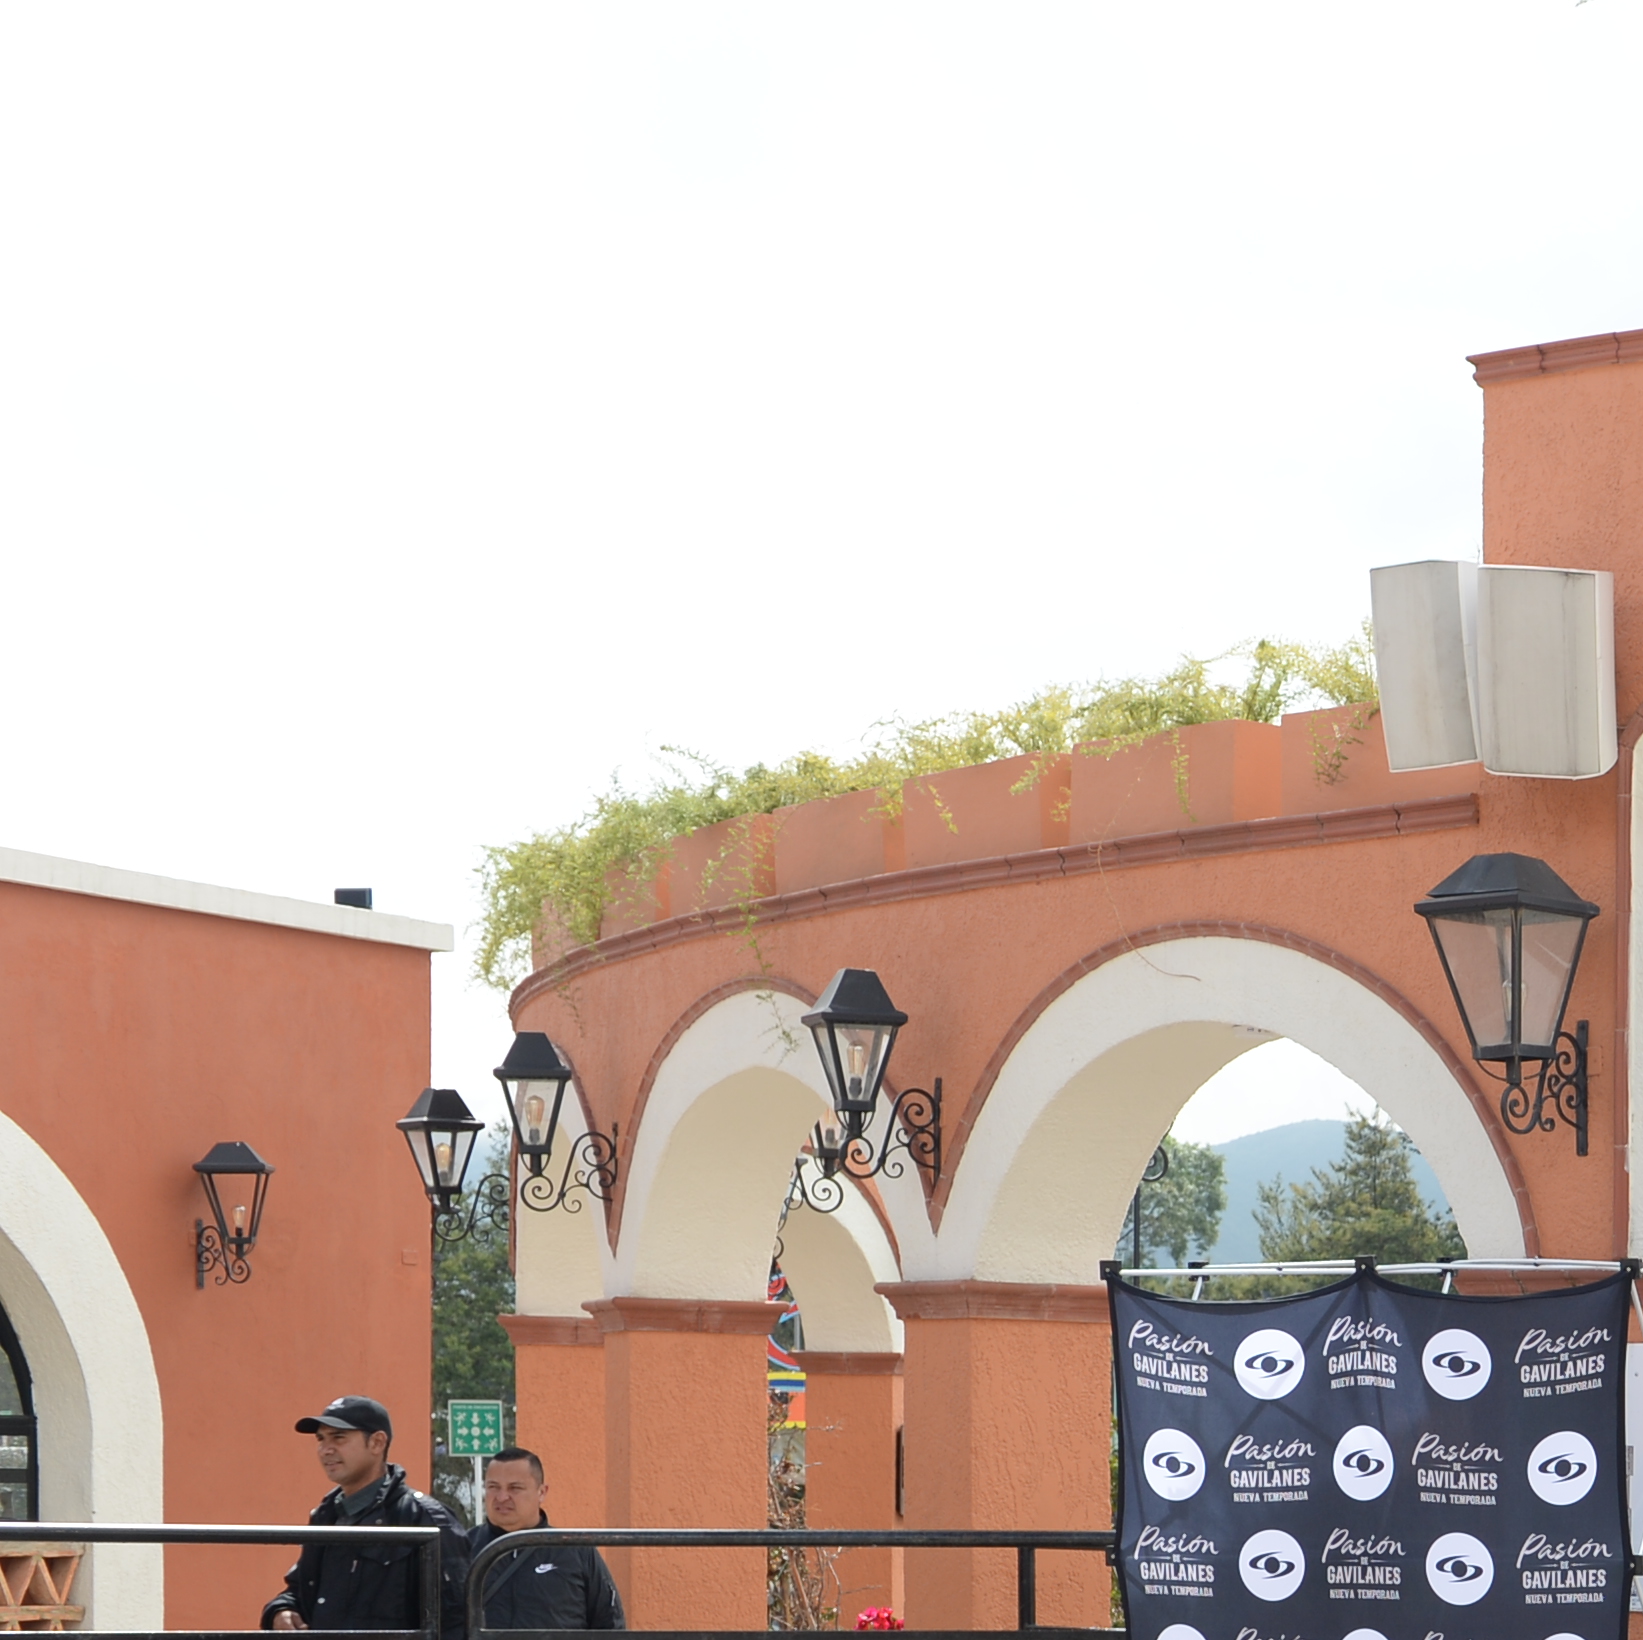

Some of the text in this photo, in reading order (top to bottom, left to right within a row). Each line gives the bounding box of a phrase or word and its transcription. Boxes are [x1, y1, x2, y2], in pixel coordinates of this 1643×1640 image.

[1128, 1320, 1213, 1355] Pasión
[1323, 1316, 1402, 1355] Pasión
[1515, 1327, 1611, 1363] Pasión
[1133, 1353, 1208, 1382] GAVILANES
[1328, 1349, 1396, 1374] GAVILANES
[1521, 1354, 1605, 1383] GAVILANES
[1224, 1435, 1316, 1468] Pasión
[1412, 1432, 1503, 1465] Pasión
[1231, 1468, 1310, 1487] GAVILANES
[1418, 1469, 1497, 1490] GAVILANES
[1234, 1491, 1308, 1502] NUEVA TEMPORADA
[1134, 1525, 1218, 1560] Pasión
[1322, 1528, 1406, 1563] Pasión
[1516, 1534, 1612, 1568] Pasión
[1140, 1562, 1214, 1582] GAVILANES
[1328, 1566, 1400, 1584] GAVILANES
[1523, 1569, 1606, 1589] GAVILANES
[1145, 1585, 1213, 1596] NUEVA TEMPORADA
[1526, 1593, 1603, 1604] NUEVA TEMPORADA
